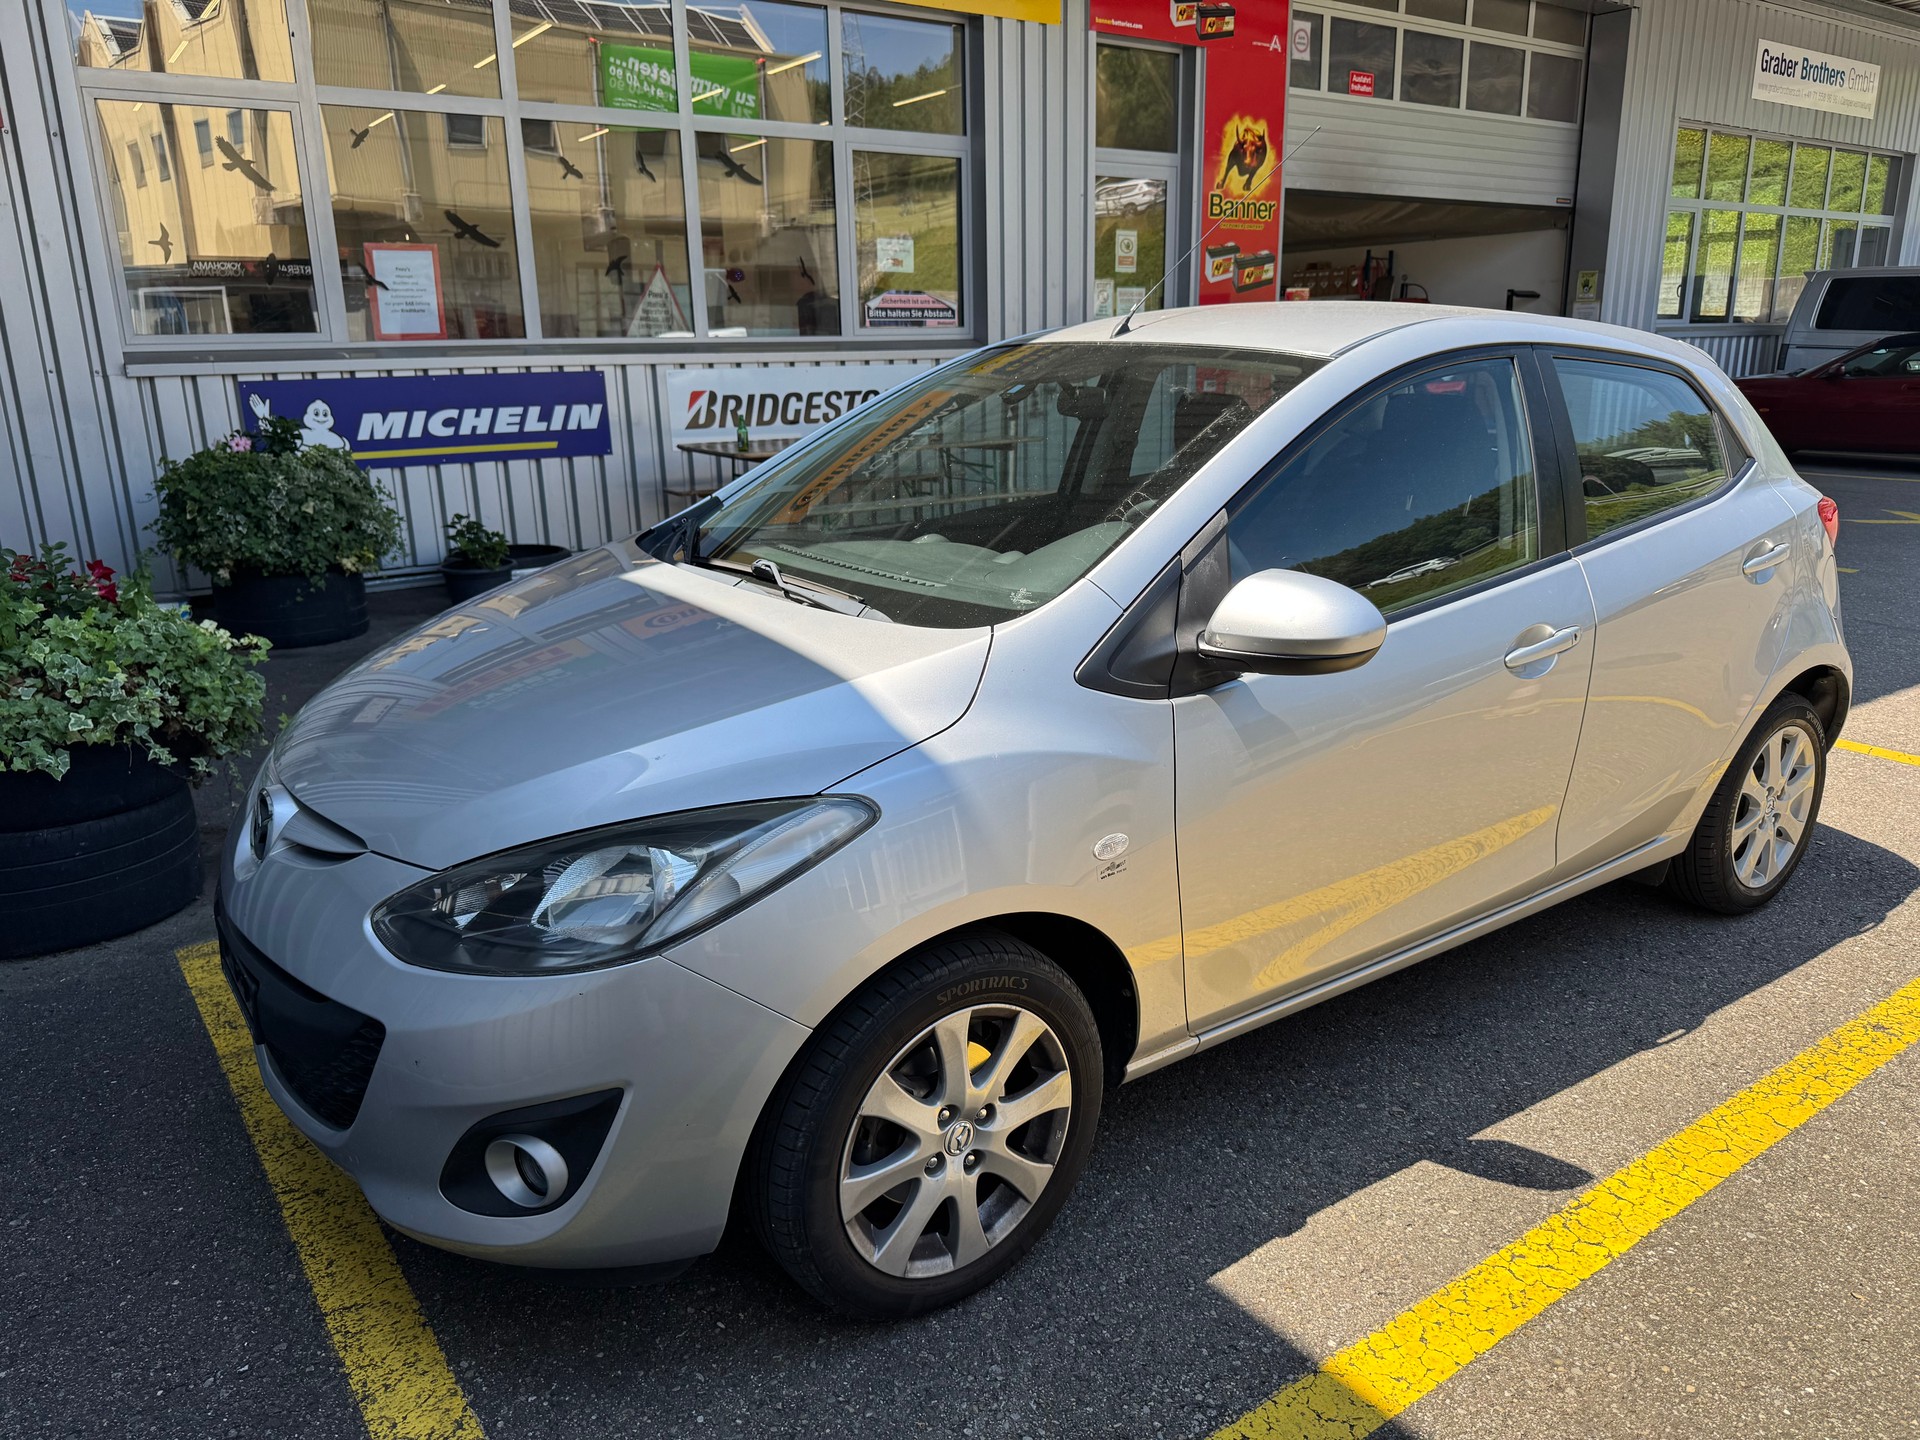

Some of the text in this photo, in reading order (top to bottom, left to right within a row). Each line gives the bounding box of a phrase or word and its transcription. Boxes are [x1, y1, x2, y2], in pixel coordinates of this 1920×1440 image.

[1760, 48, 1876, 94] Graber Brothers GmbH
[1209, 192, 1277, 221] Banner
[868, 309, 954, 319] Bitte halten Sie Abstand.
[356, 403, 603, 441] MICHELIN
